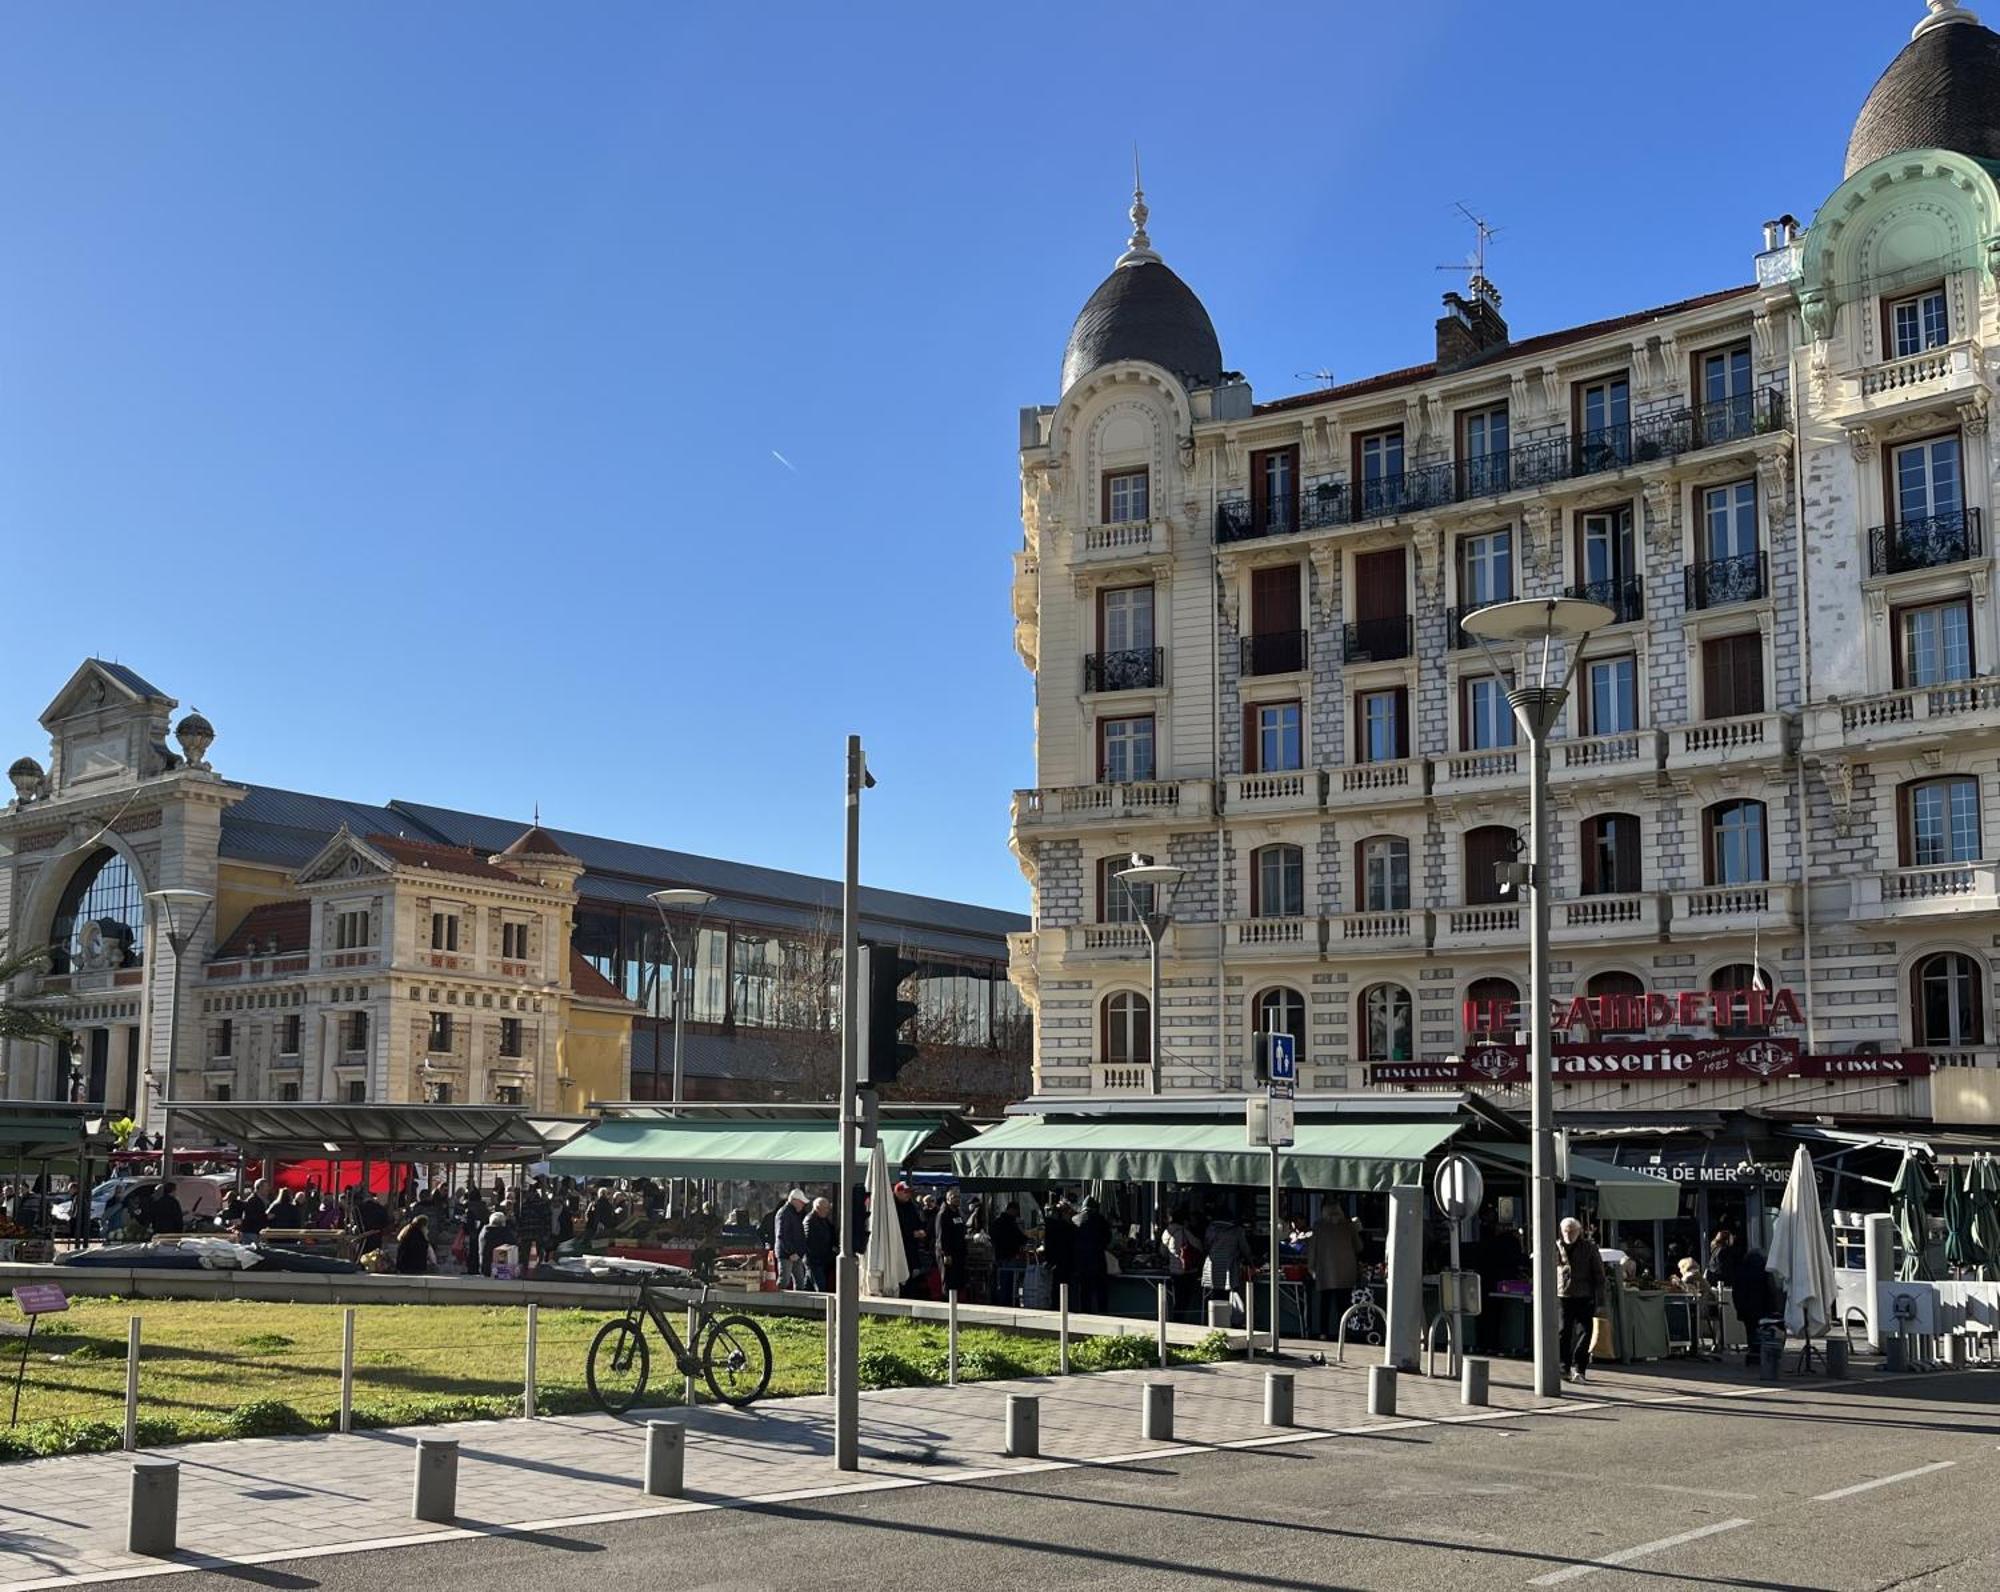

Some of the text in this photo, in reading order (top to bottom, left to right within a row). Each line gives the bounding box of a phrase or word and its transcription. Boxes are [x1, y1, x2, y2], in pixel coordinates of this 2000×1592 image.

[1463, 999, 1512, 1032] LE
[1376, 1067, 1458, 1078] RESTAURANT
[1672, 1167, 1695, 1180] DE
[1700, 1168, 1737, 1182] MER
[1764, 1168, 1824, 1184] POISS
